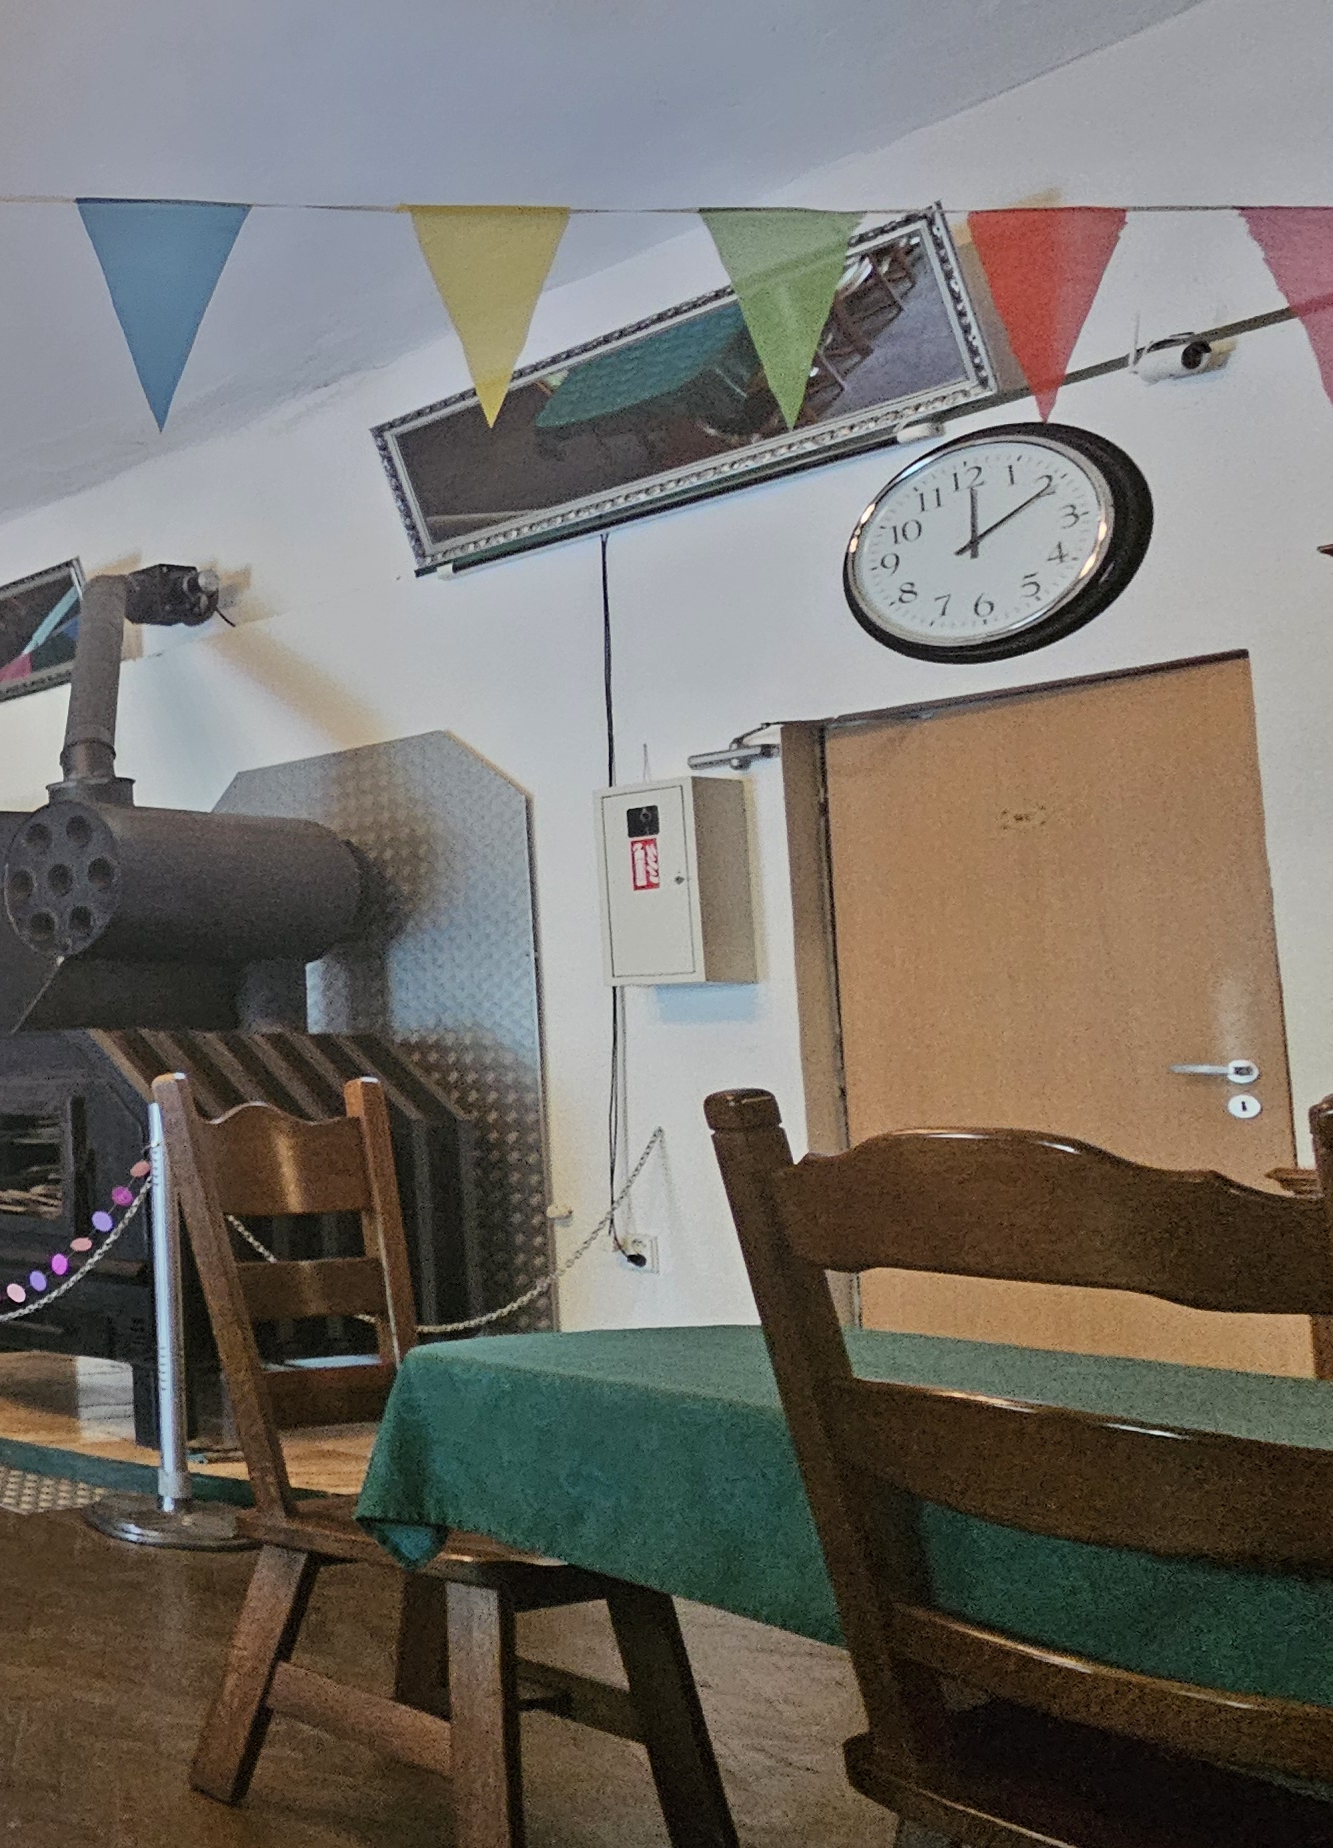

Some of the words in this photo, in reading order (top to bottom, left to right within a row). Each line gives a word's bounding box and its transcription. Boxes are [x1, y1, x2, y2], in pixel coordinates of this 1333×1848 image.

[952, 465, 985, 491] 12
[1007, 464, 1016, 486] 1
[1034, 473, 1056, 500] 2
[917, 487, 941, 512] 11
[1060, 503, 1080, 529] 3
[891, 519, 922, 545] 10
[880, 552, 900, 576] 9
[1046, 540, 1069, 564] 4
[898, 581, 918, 604] 8
[1020, 572, 1040, 598] 5
[934, 593, 951, 617] 7
[974, 592, 995, 618] 6
